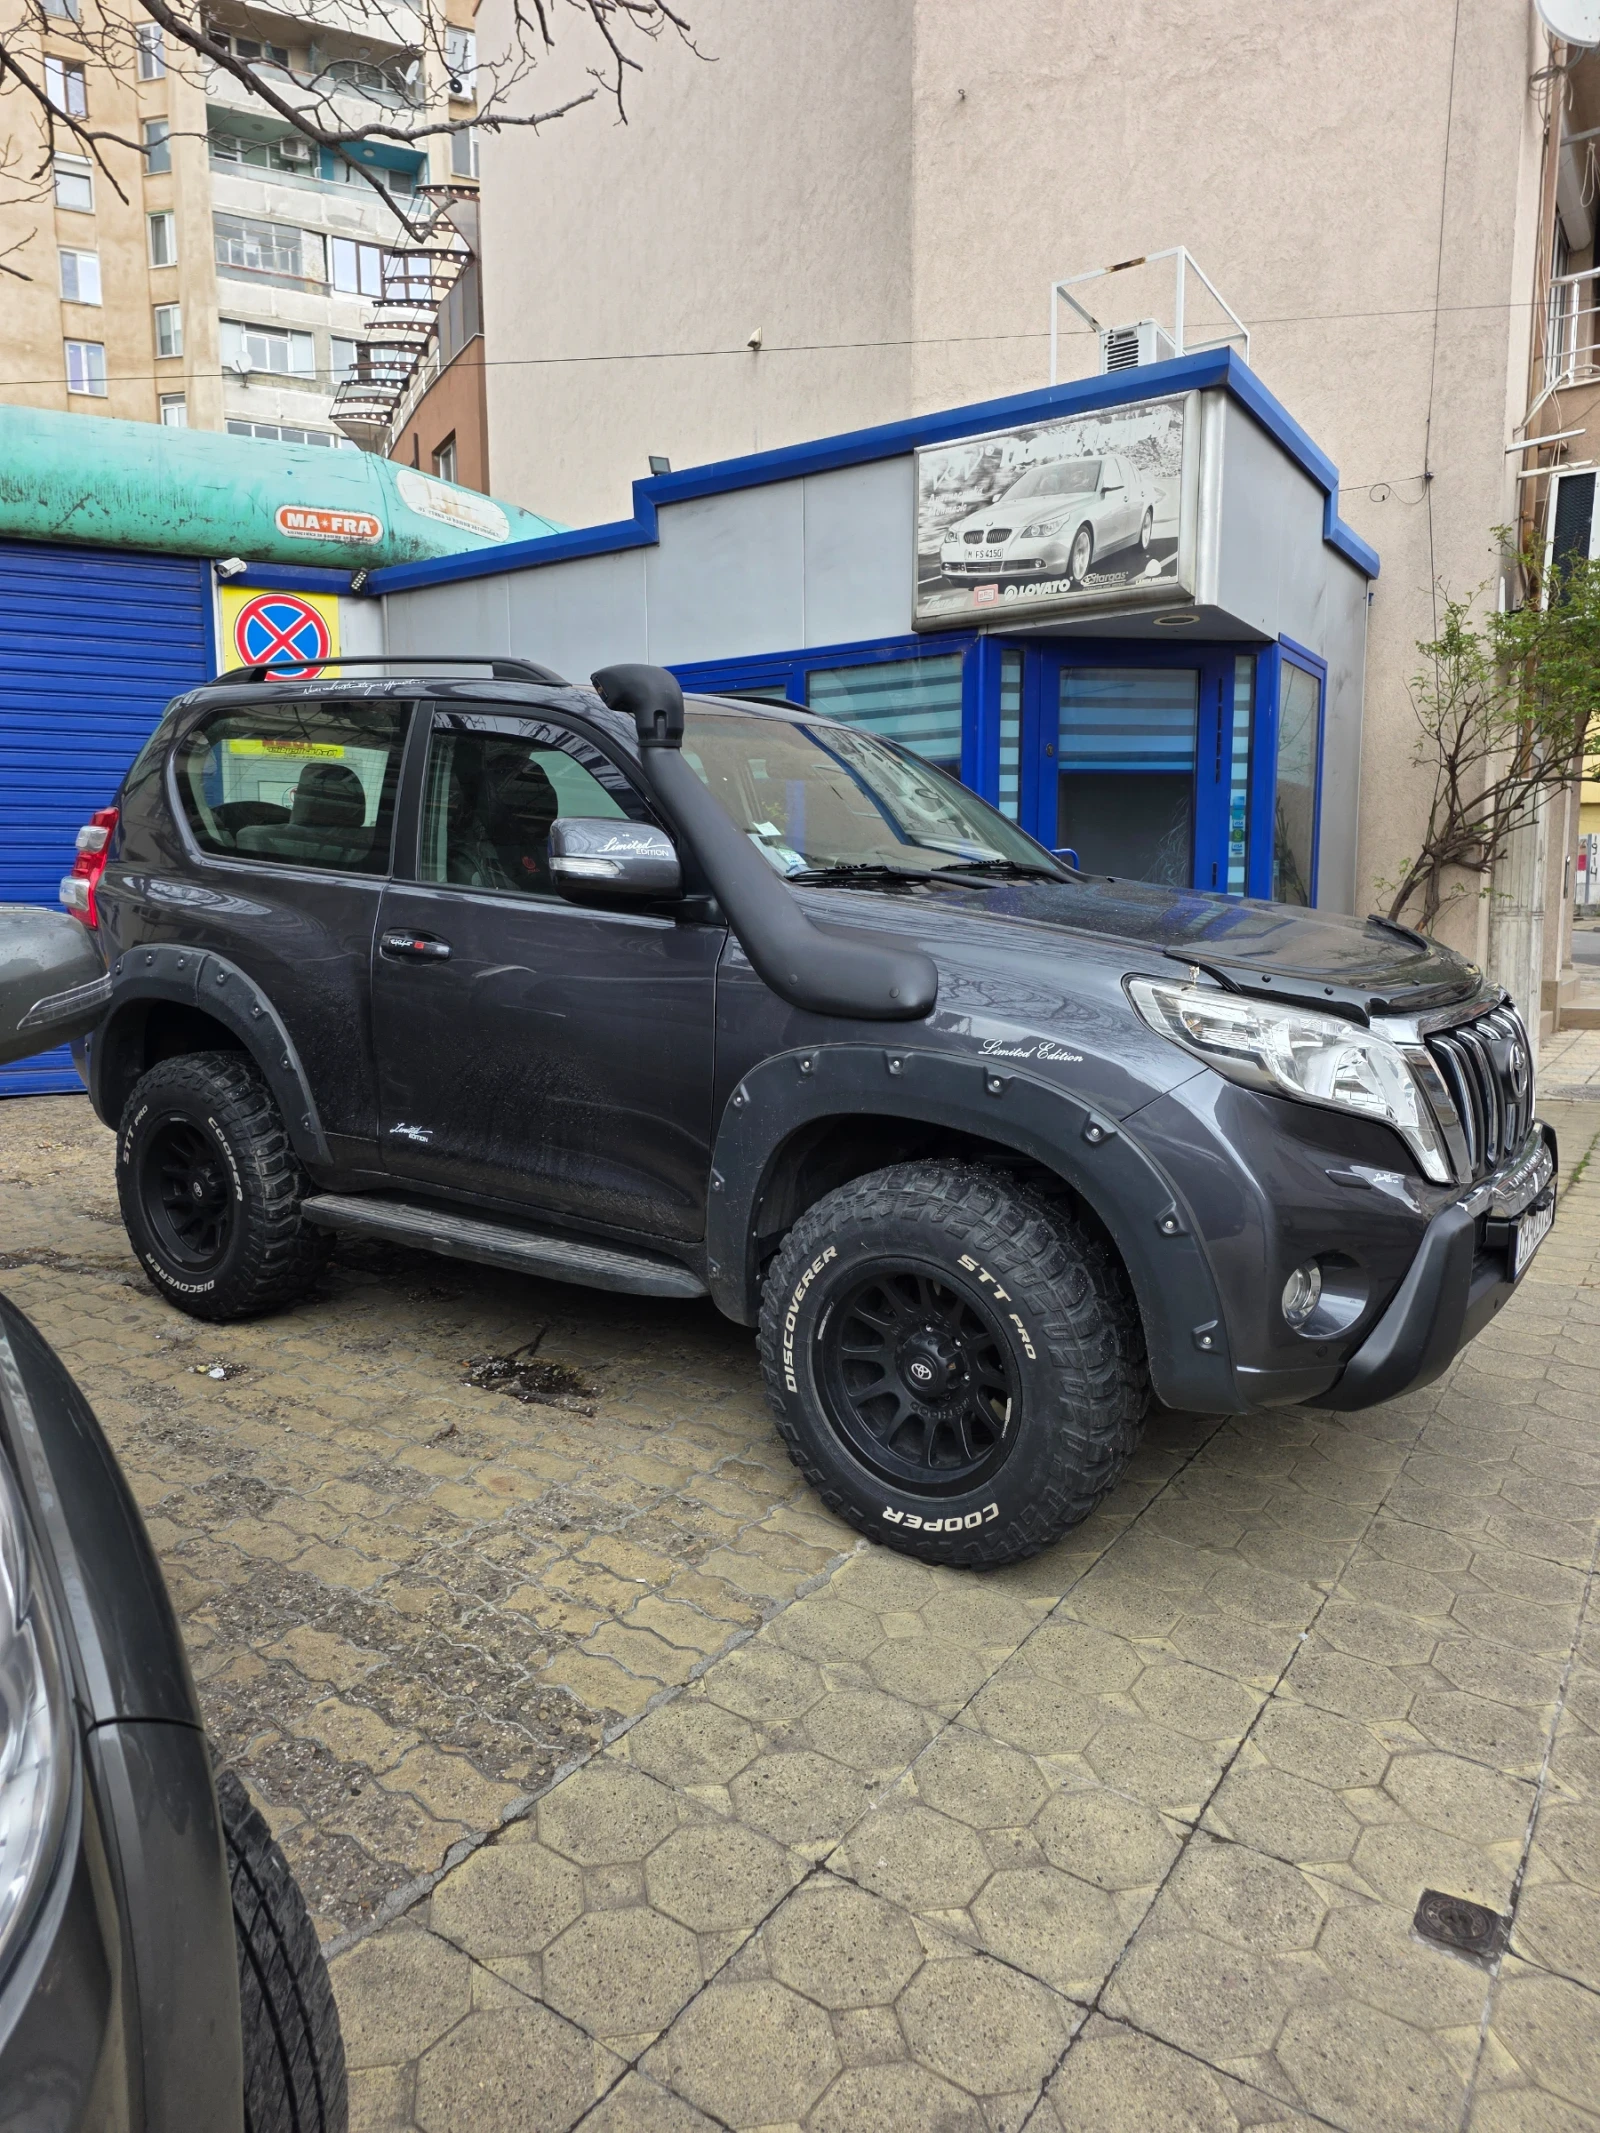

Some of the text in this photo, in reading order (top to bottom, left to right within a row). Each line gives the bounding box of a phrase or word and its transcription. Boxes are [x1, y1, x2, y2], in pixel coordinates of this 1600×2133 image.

[1018, 578, 1071, 598] LOVATO
[597, 835, 671, 852] Limited
[635, 848, 669, 857] EDITION
[978, 1038, 1084, 1062] Limited Edition
[207, 1116, 243, 1202] COOPER
[146, 1252, 215, 1294] DISCOVERER
[783, 1245, 838, 1394] DISCOVERER
[956, 1253, 1038, 1361] STT PRO
[881, 1501, 1001, 1533] COOPER
